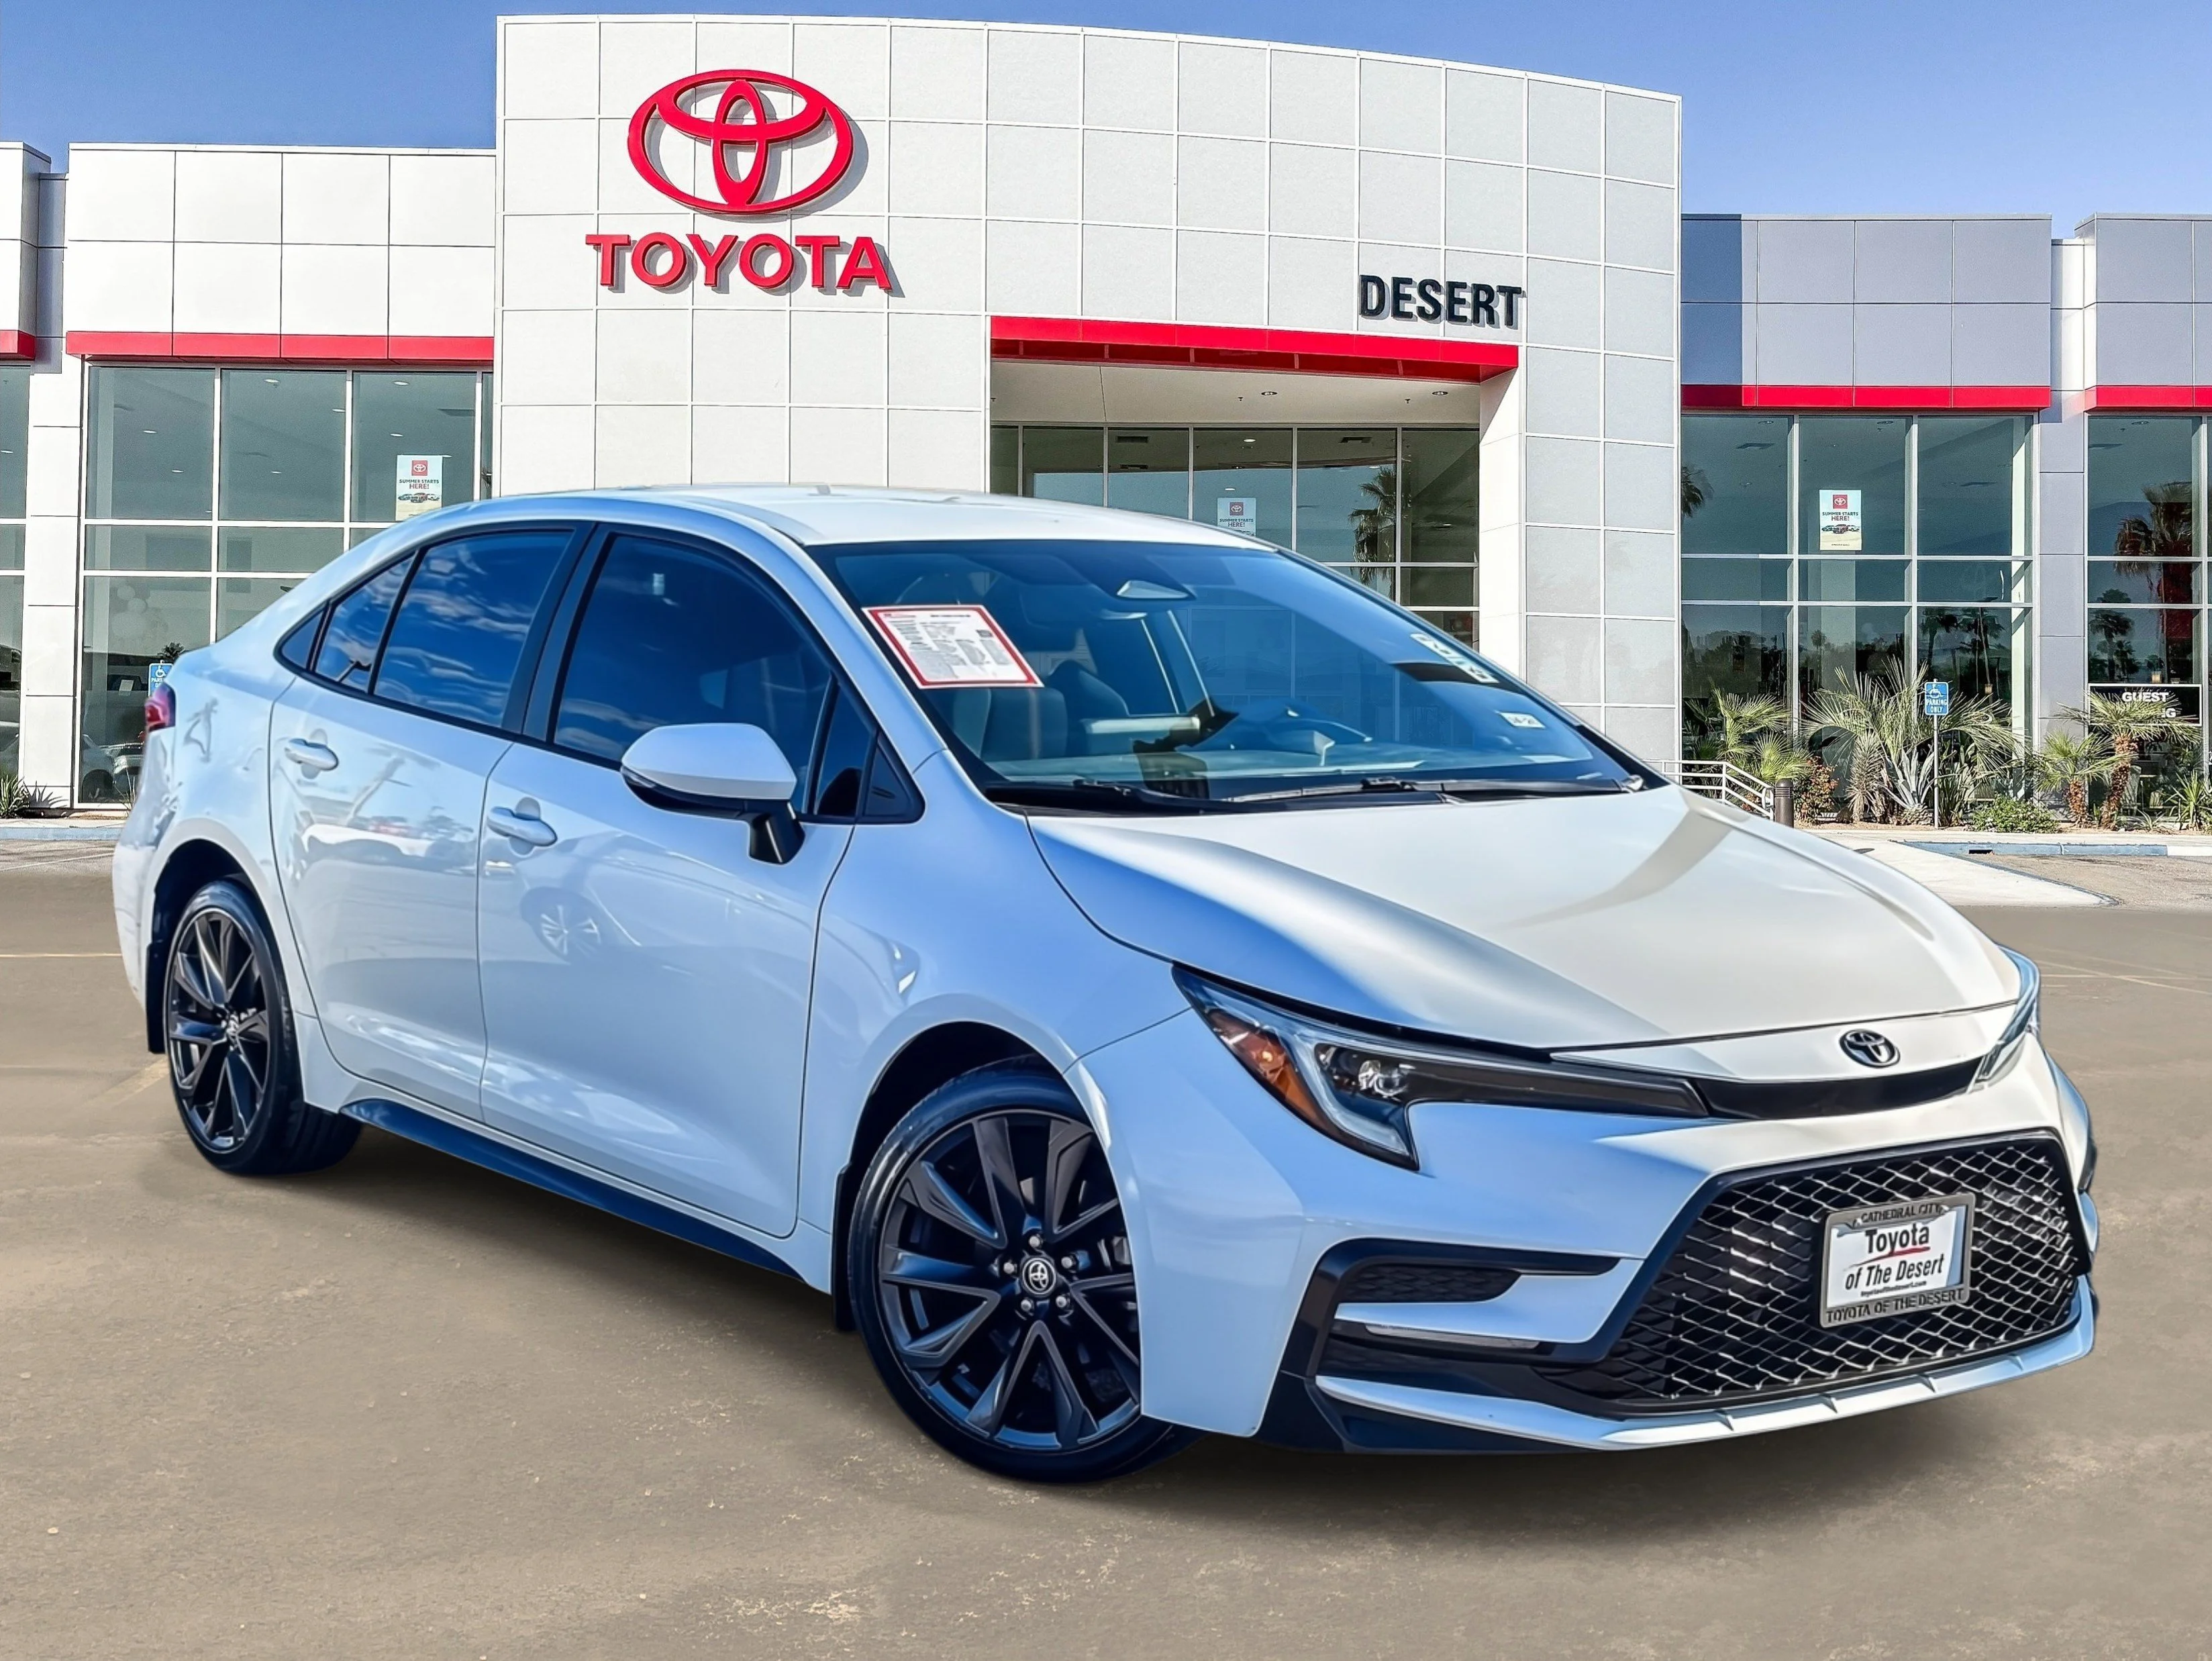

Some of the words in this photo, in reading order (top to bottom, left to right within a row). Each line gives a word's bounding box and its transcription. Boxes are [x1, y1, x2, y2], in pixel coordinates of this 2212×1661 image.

[586, 232, 893, 290] TOYOTA
[1359, 274, 1522, 327] DESERT
[2122, 691, 2169, 702] GUEST
[1861, 1206, 1915, 1223] CATHEDRAL
[1865, 1222, 1930, 1256] Toyota
[1846, 1267, 1863, 1291] of
[1865, 1264, 1892, 1287] The
[1896, 1254, 1944, 1280] Desert
[1826, 1306, 1870, 1323] TOYOTA
[1874, 1299, 1891, 1313] OF
[1895, 1295, 1917, 1311] THE
[1919, 1289, 1964, 1306] DESERT
